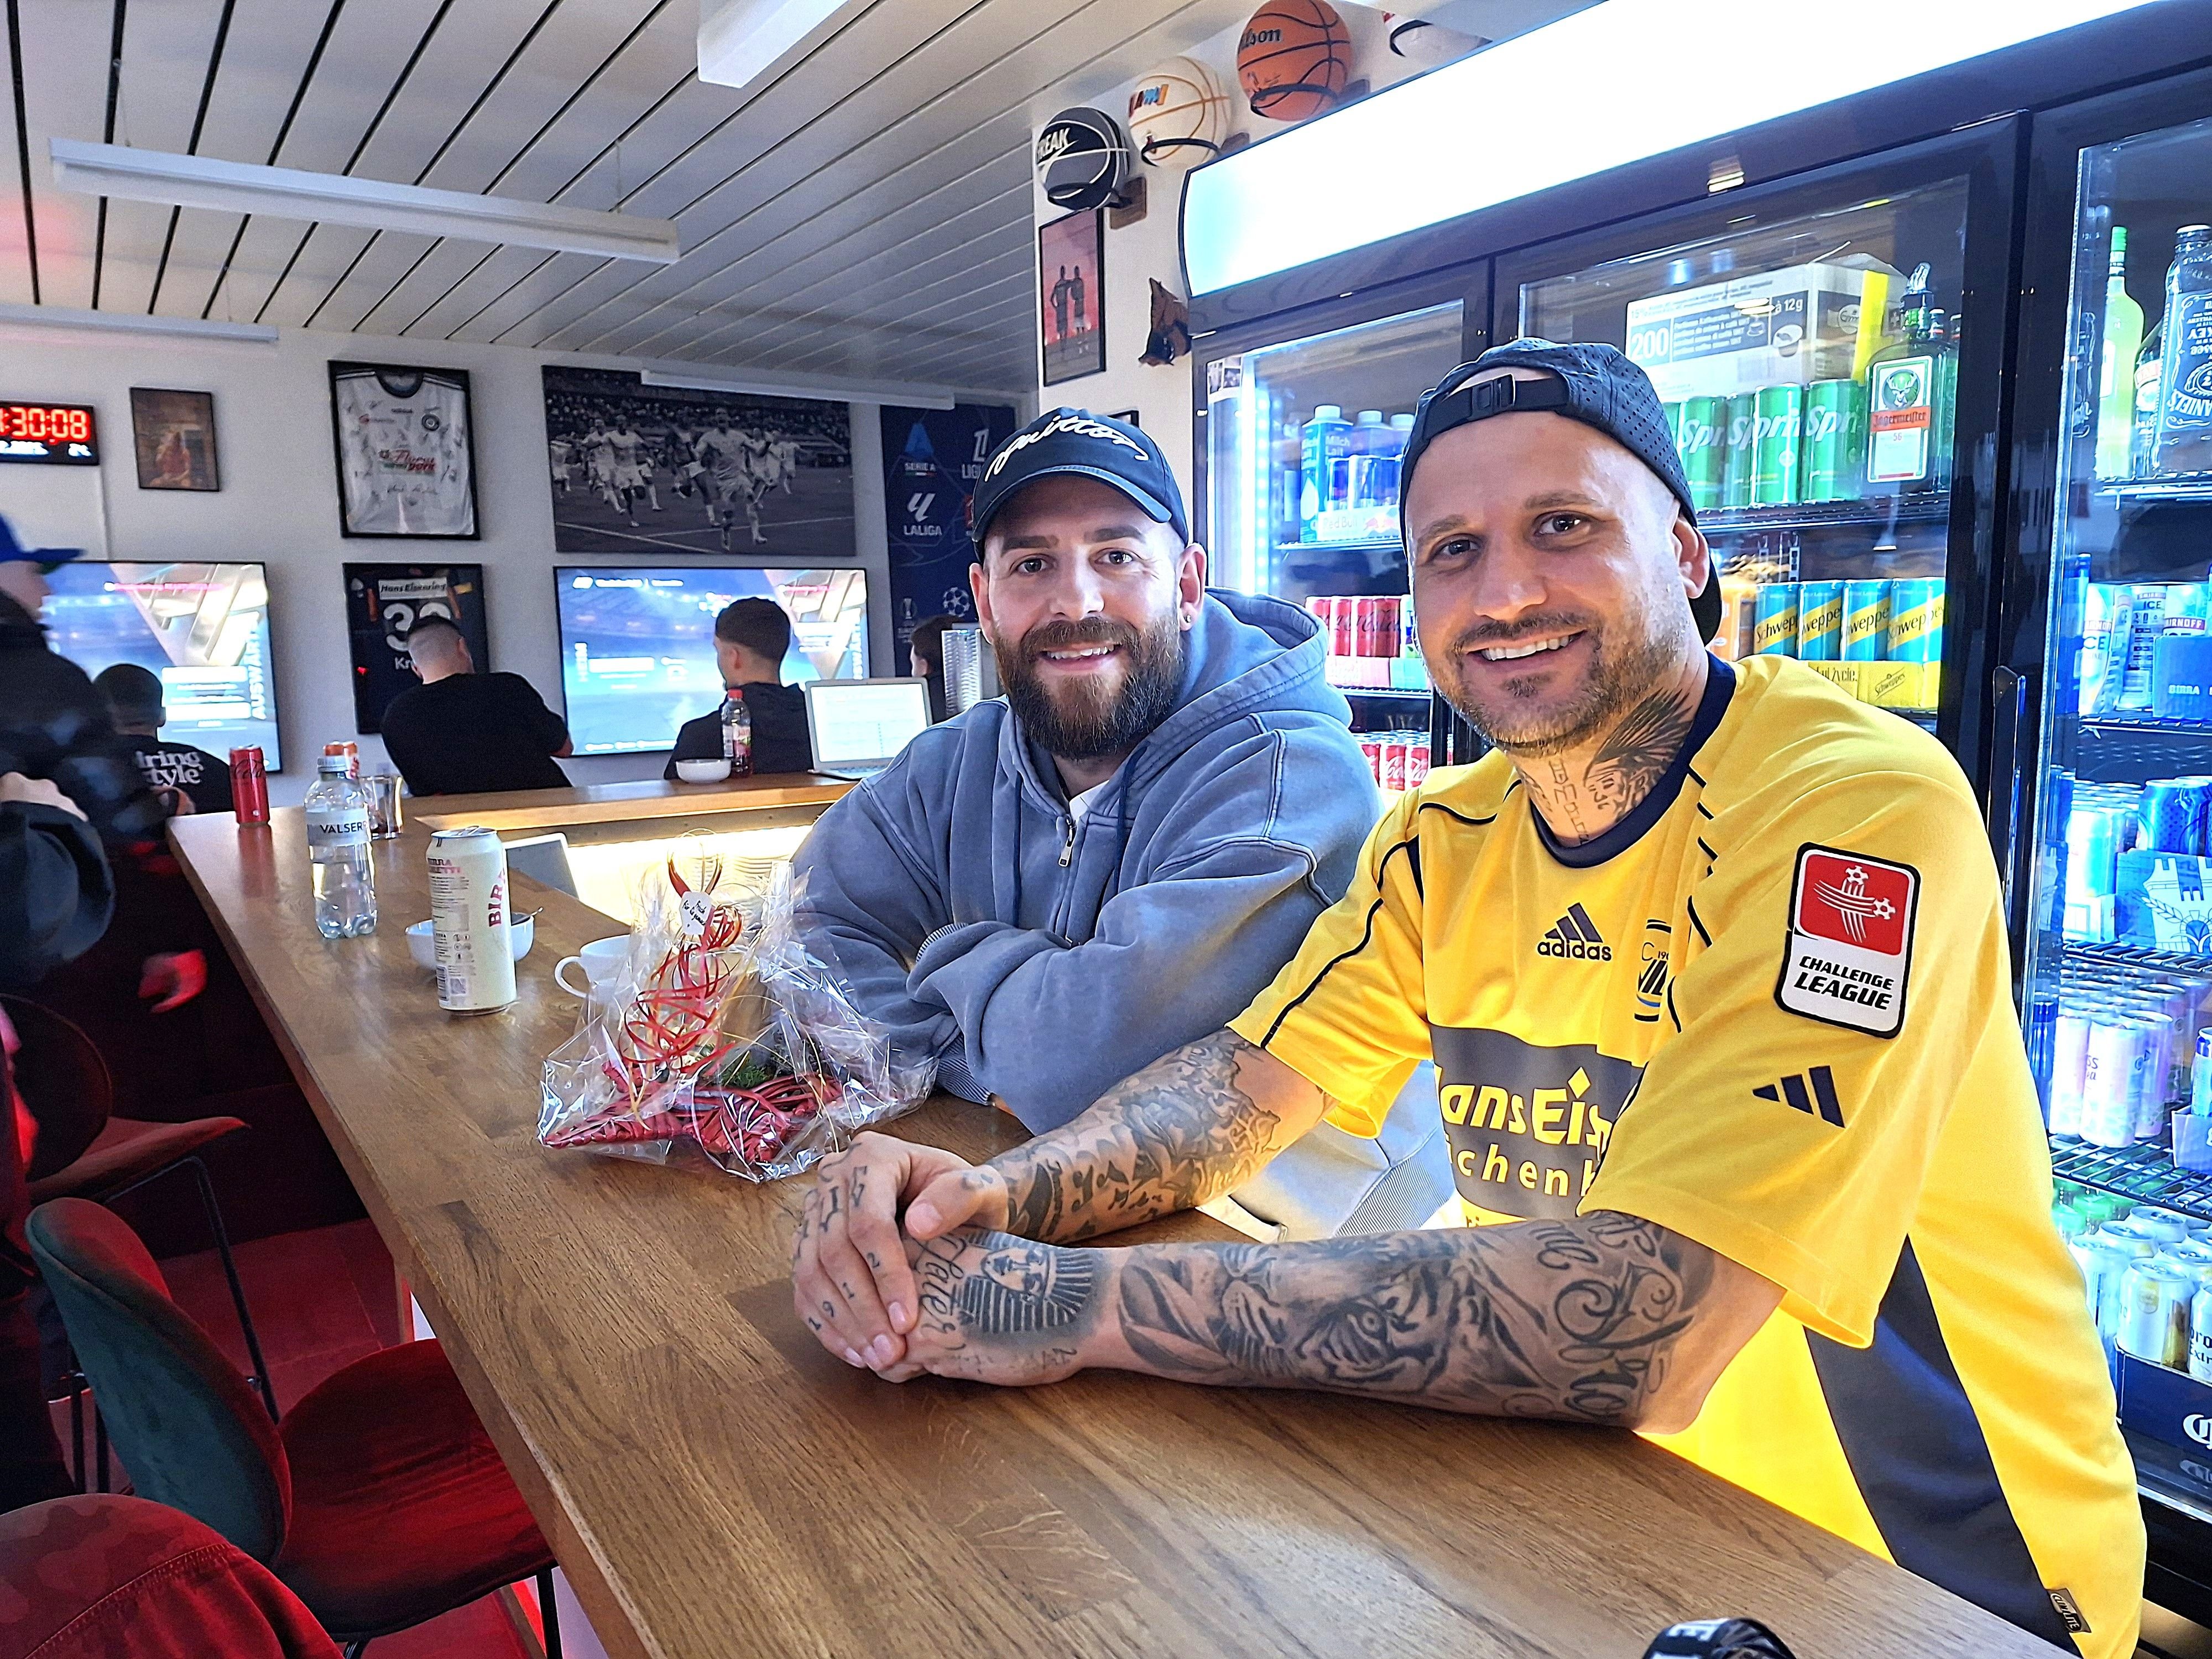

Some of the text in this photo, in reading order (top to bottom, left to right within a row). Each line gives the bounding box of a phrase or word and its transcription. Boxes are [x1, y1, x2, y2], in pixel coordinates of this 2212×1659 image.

[1785, 298, 1803, 312] 12g
[1631, 326, 1670, 360] 200
[903, 525, 943, 536] LALIGA
[2143, 601, 2162, 609] ICE
[320, 822, 363, 834] VALSER
[1537, 938, 1612, 961] adidas
[1798, 956, 1895, 990] CHALLENGE
[1793, 971, 1893, 1010] LEAGUE
